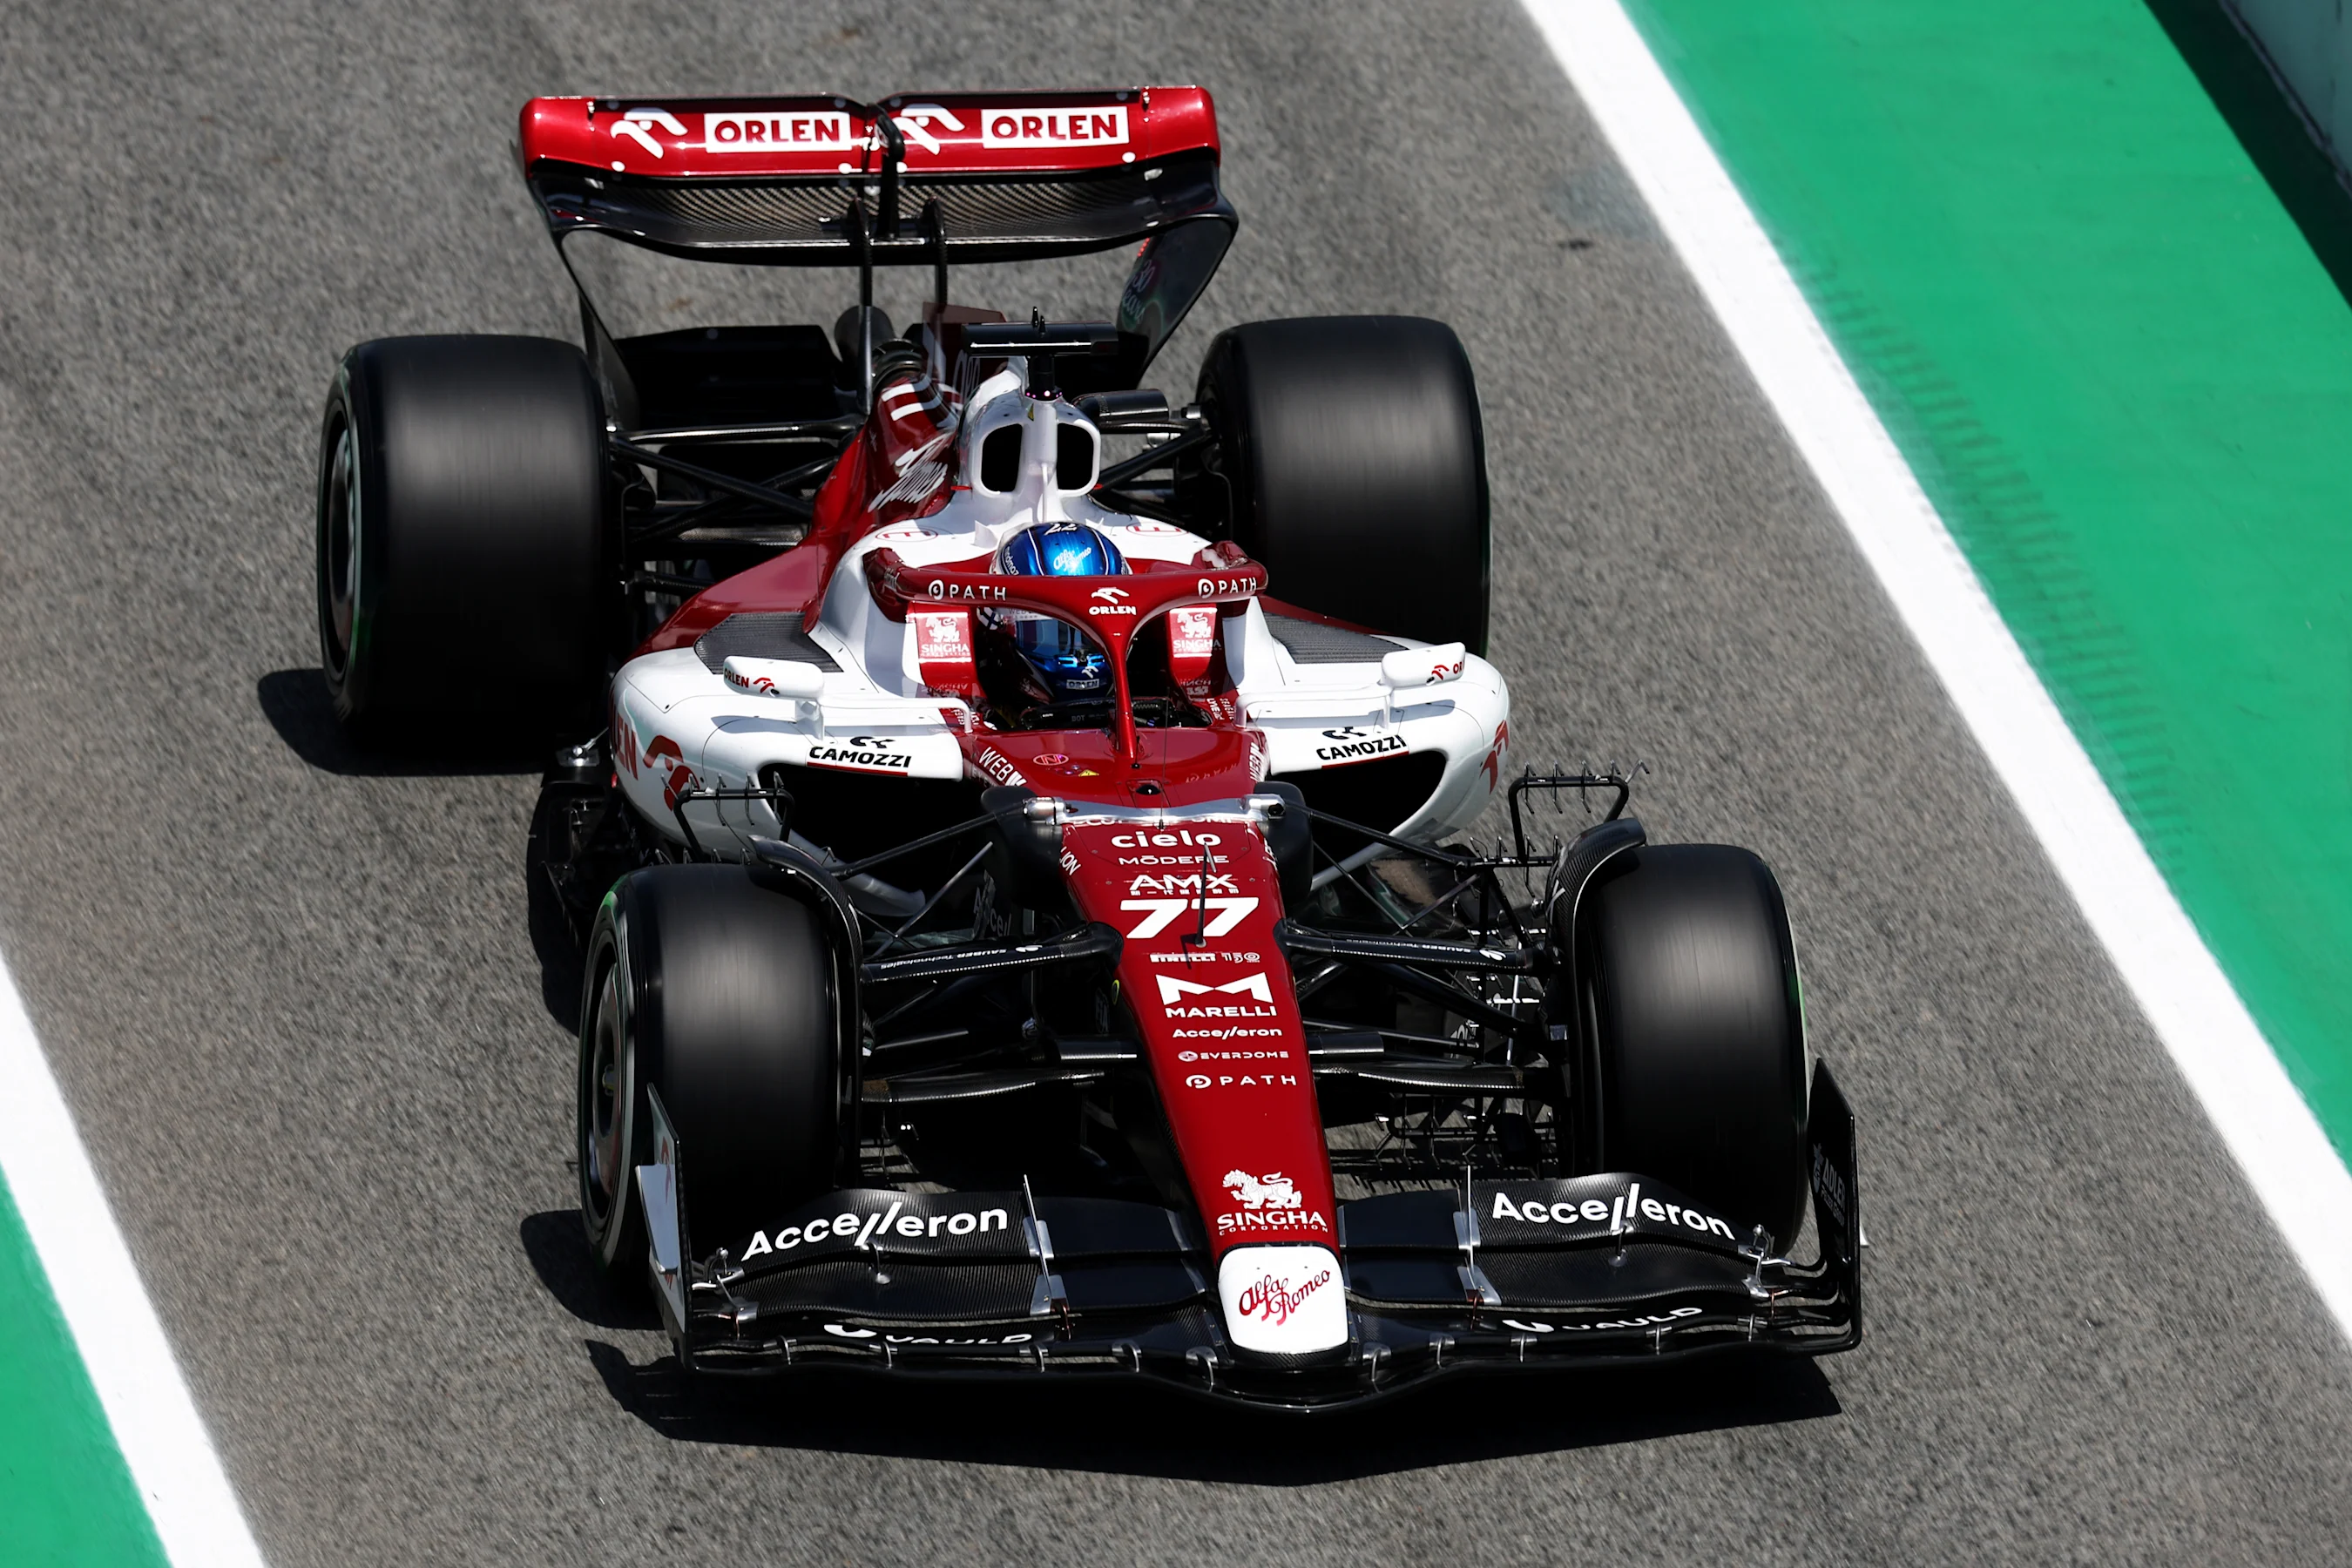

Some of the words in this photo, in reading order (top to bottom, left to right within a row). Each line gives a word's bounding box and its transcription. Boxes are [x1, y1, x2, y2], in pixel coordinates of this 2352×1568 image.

[713, 118, 841, 143] ORLEN
[990, 114, 1119, 140] ORLEN
[949, 584, 1007, 601] PATH
[1220, 577, 1257, 595] PATH
[1089, 605, 1137, 616] ORLEN
[921, 643, 970, 653] SINGHA
[1173, 639, 1221, 649] SINGHA
[1316, 735, 1409, 760] CAMOZZI
[809, 747, 912, 768] CAMOZZI
[1111, 830, 1221, 848] cielo
[1129, 874, 1238, 890] AMX
[1120, 897, 1259, 938] 77
[880, 955, 954, 970] Technologies
[957, 949, 1007, 959] SAUBER
[1165, 1005, 1277, 1018] MARELLI
[1173, 1026, 1283, 1040] Accelleron
[1200, 1051, 1289, 1059] EVERDOME
[1220, 1075, 1297, 1086] PATH
[1492, 1183, 1736, 1240] Accelleron
[1216, 1210, 1327, 1231] SINGHA
[742, 1201, 1008, 1262] Accelleron
[1220, 1224, 1328, 1236] CORPORATION
[1238, 1274, 1284, 1321] Alfa
[1265, 1269, 1331, 1327] Romeo
